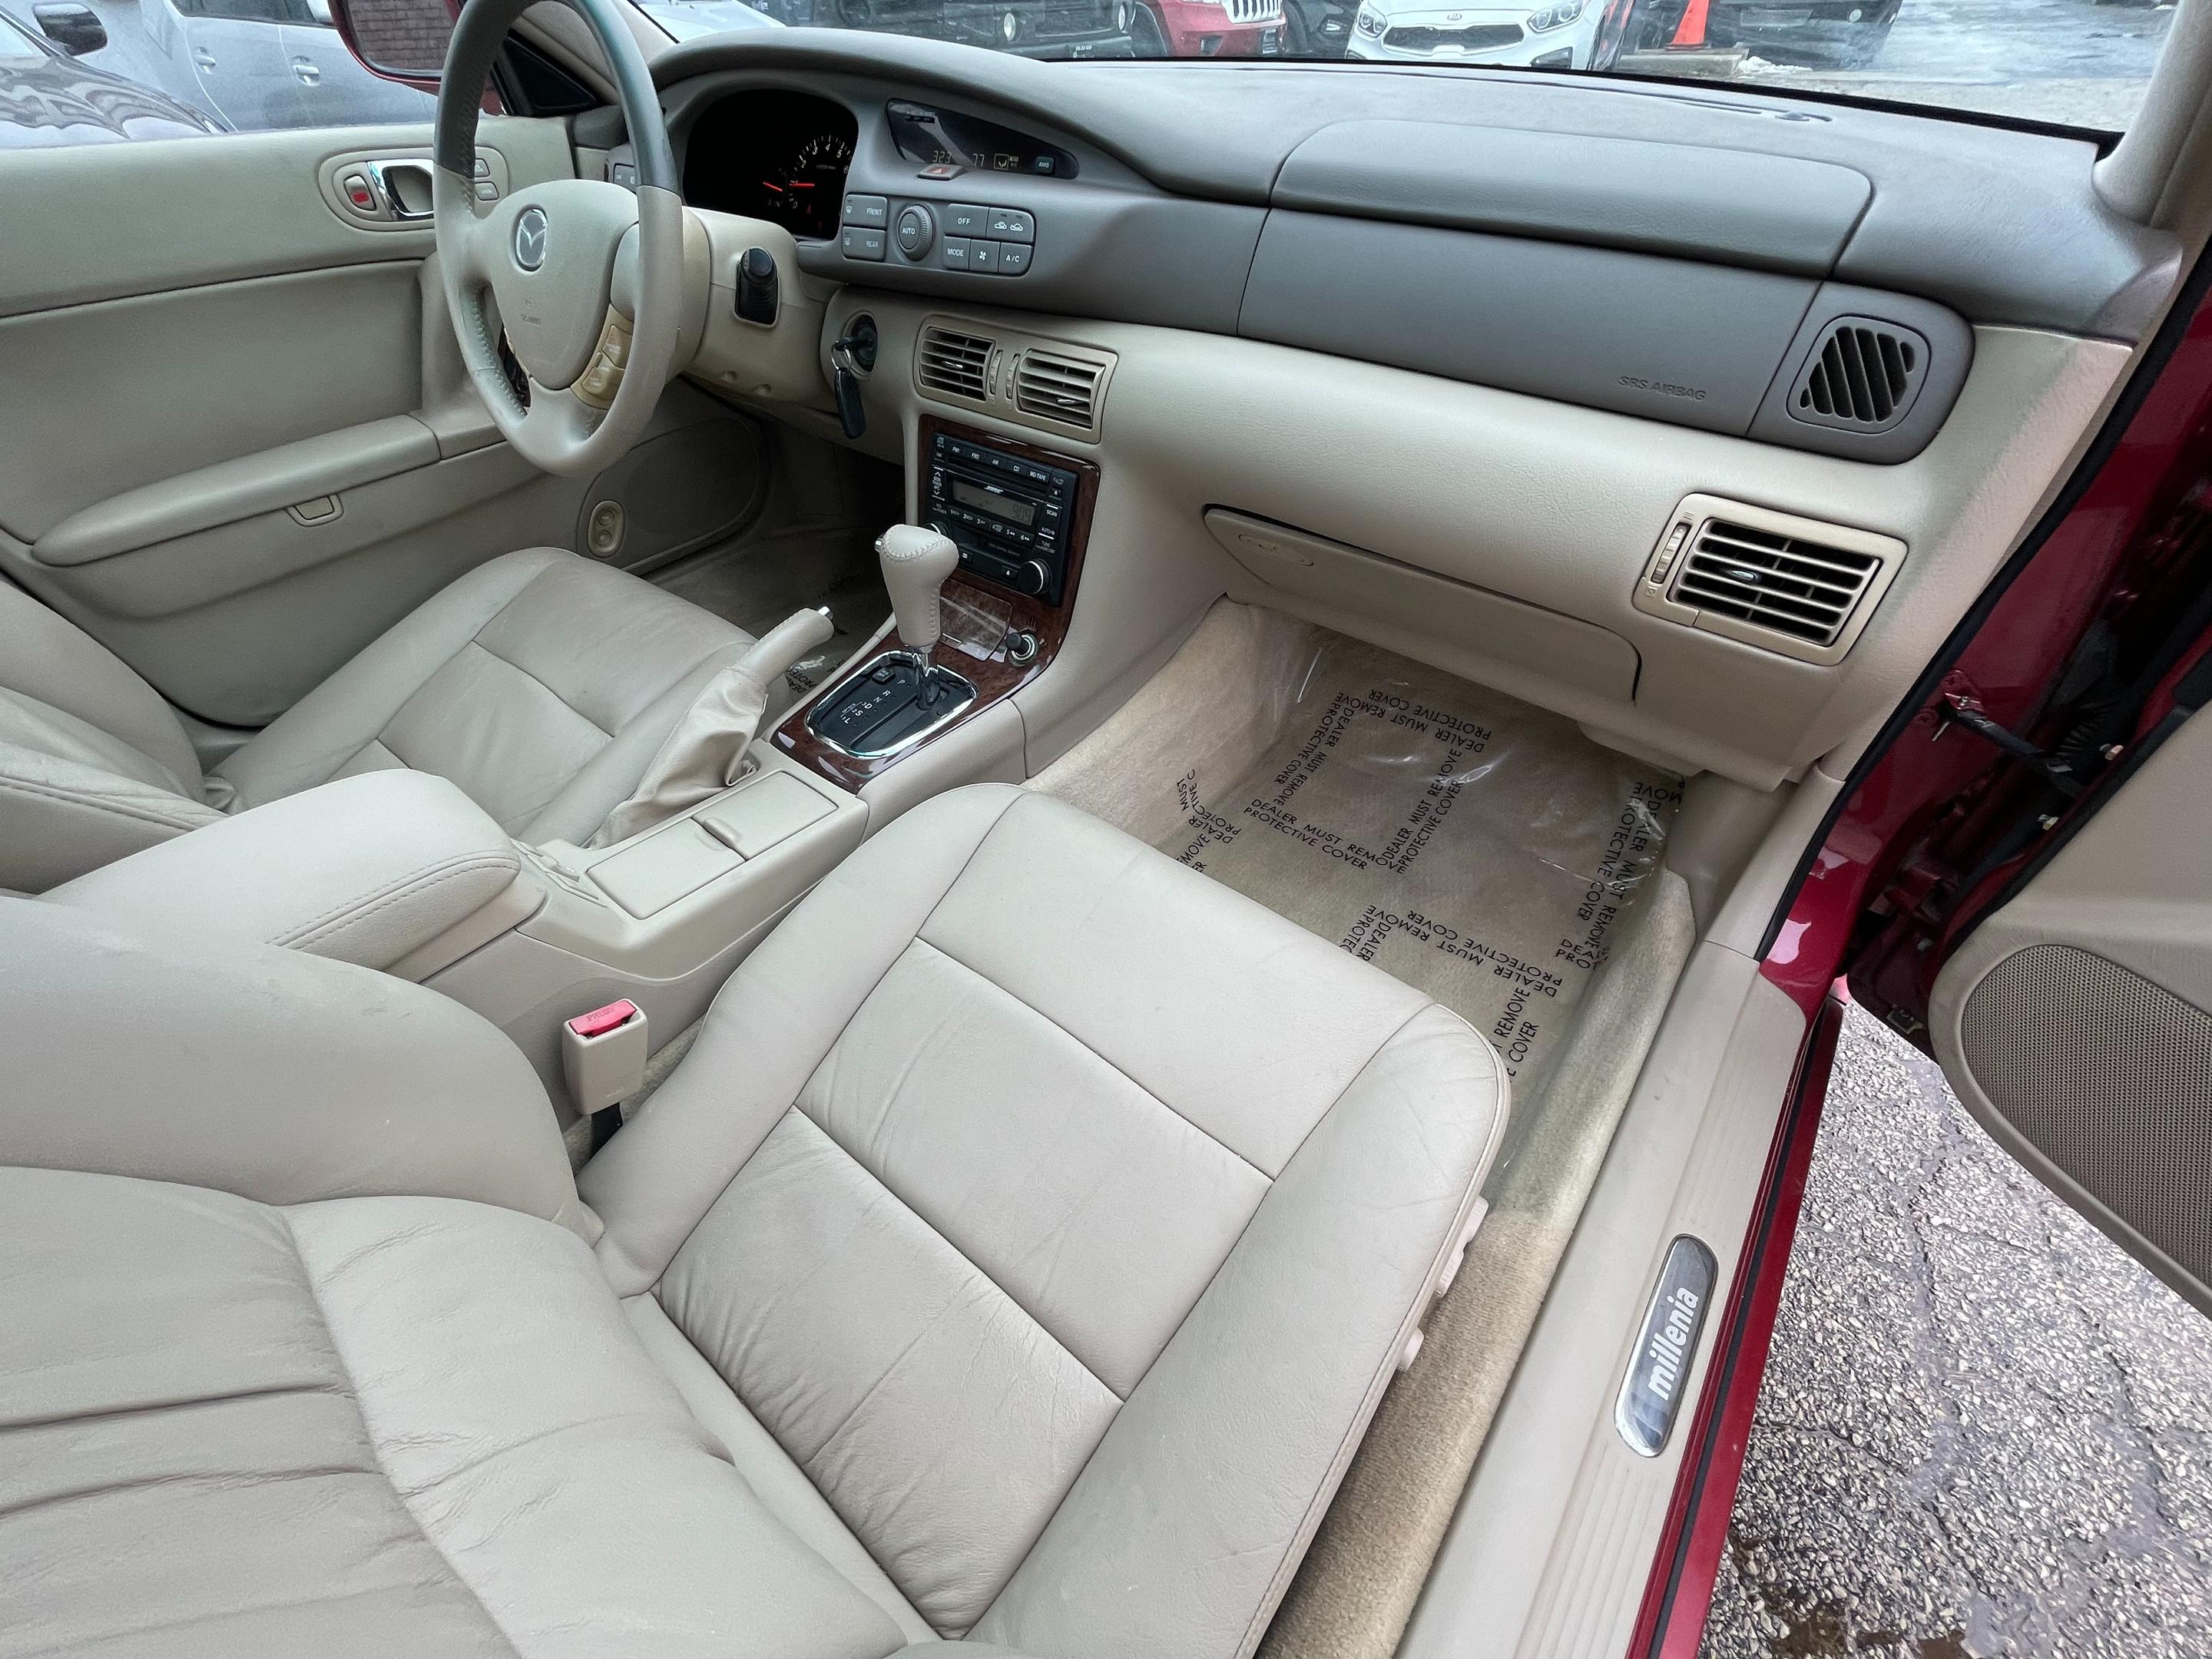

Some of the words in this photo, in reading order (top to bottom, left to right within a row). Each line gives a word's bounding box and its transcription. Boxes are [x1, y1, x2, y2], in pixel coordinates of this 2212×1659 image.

[866, 207, 882, 217] FRONT
[958, 217, 971, 226] OFF
[902, 227, 916, 235] AUTO
[947, 247, 965, 257] MODE
[1005, 254, 1020, 263] A/C
[1618, 376, 1648, 389] SRS
[1649, 382, 1707, 401] AIRBAG
[1334, 692, 1386, 718] REMOVE
[1369, 689, 1409, 711] COVER
[1298, 702, 1341, 760] PROTECTIVE
[1325, 707, 1355, 747] DEALER
[1390, 714, 1429, 733] MUST
[1413, 705, 1492, 740] PROTECTIVE
[1435, 727, 1485, 753] DEALER
[1274, 760, 1301, 784] COVER
[1304, 751, 1327, 773] MUST
[1177, 778, 1189, 811] MUST
[1273, 773, 1307, 806] REMOVE
[1382, 827, 1413, 860] DEALER
[1408, 800, 1432, 825] MUST
[1427, 749, 1462, 796] REMOVE
[1190, 783, 1242, 835] PROTECTIVE
[1398, 816, 1442, 867] PROTECTIVE
[1435, 780, 1464, 816] COVER
[1188, 816, 1233, 843] DEALER
[1243, 806, 1319, 846] PROTECTIVE
[1322, 845, 1368, 869] COVER
[1251, 799, 1297, 824] DEALER
[1303, 823, 1343, 845] MUST
[1347, 843, 1406, 874] REMOVE
[1610, 860, 1637, 900] MUST
[1577, 881, 1604, 921] COVER
[1366, 905, 1430, 942] REMOVE
[1407, 910, 1458, 940] COVER
[1584, 905, 1617, 949] REMOVE
[1356, 922, 1391, 962] DEALER
[1436, 940, 1484, 966] MUST
[1463, 938, 1563, 986] PROTECTIVE
[1494, 965, 1558, 998] DEALER
[586, 1007, 614, 1022] PRESS
[1494, 987, 1530, 1038] REMOVE
[1508, 1022, 1539, 1062] COVER
[1648, 1286, 1699, 1401] millenia
